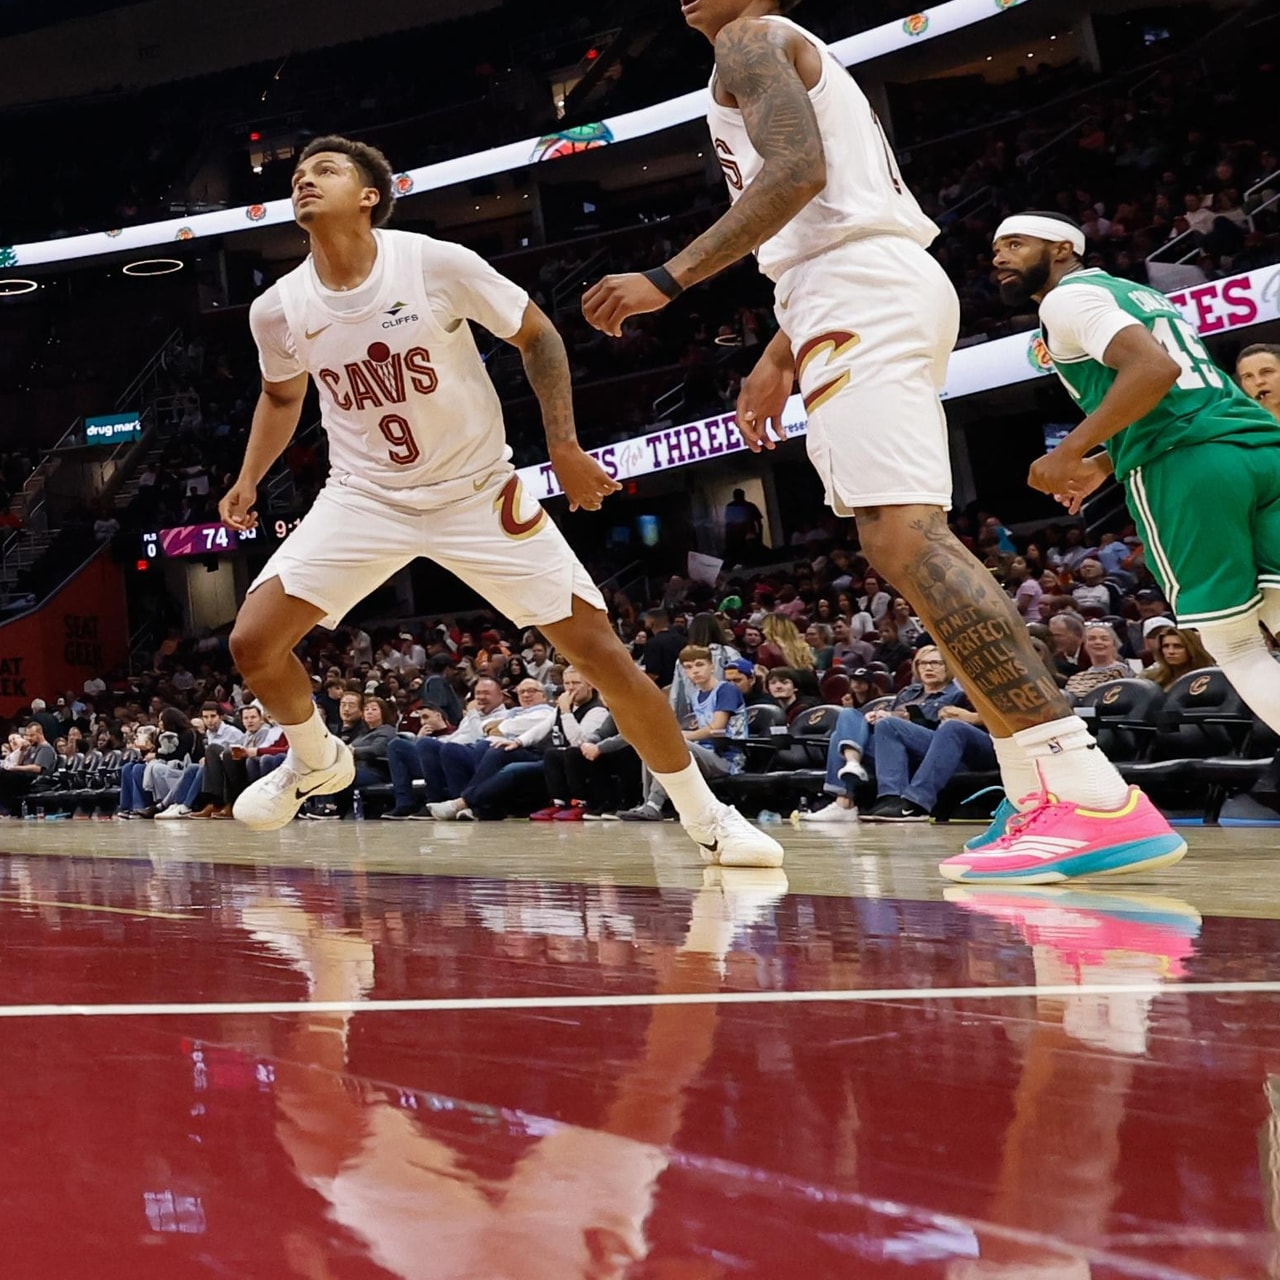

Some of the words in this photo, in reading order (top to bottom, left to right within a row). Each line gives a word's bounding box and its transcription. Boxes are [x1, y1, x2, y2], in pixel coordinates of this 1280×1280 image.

[382, 313, 420, 329] CLIFFS
[319, 347, 438, 411] CAVS
[86, 422, 113, 437] drug
[378, 414, 420, 465] 9
[646, 414, 752, 468] THREE
[147, 543, 157, 558] 0
[202, 527, 229, 549] 74
[948, 619, 1014, 660] PERFECT
[975, 660, 1028, 691] ALWAYS
